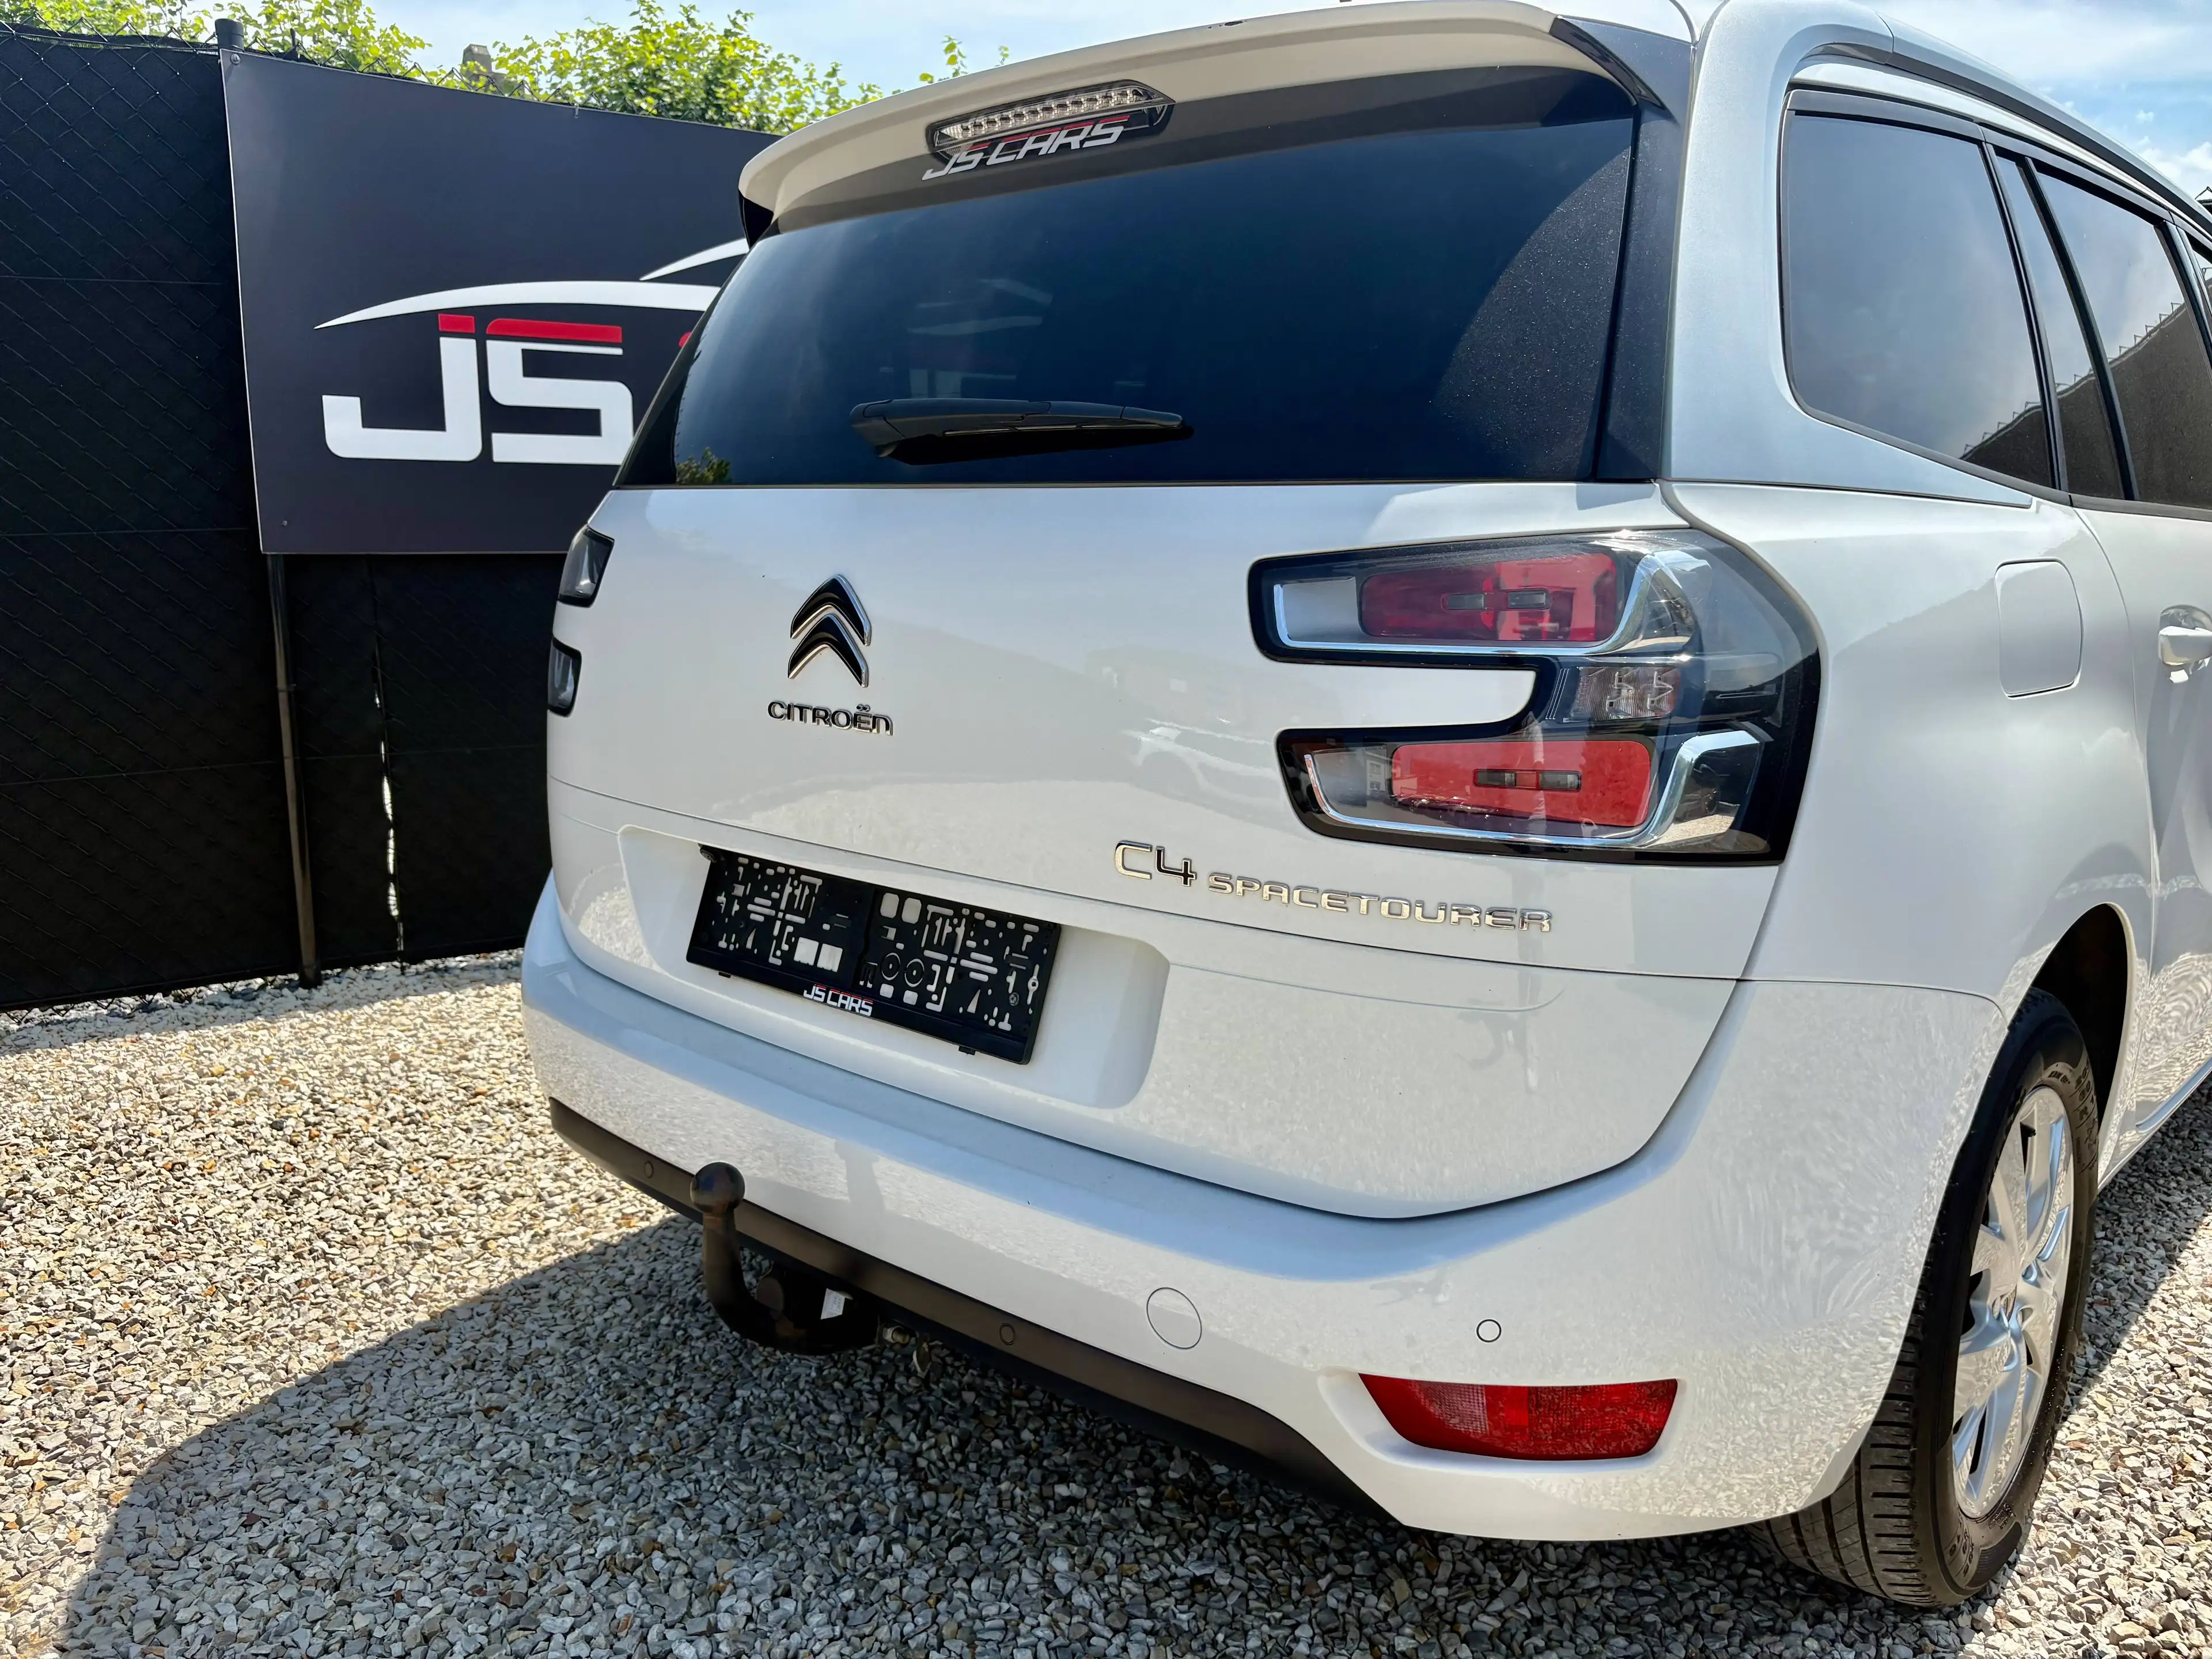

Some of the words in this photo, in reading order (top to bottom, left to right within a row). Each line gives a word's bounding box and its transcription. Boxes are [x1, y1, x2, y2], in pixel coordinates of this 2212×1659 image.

[922, 142, 991, 180] JS
[987, 115, 1130, 165] CARS
[321, 313, 635, 465] JS
[1115, 840, 1198, 887] C4
[1208, 872, 1553, 933] SPACETOURER
[803, 983, 827, 1002] JS
[827, 988, 873, 1017] CARS
